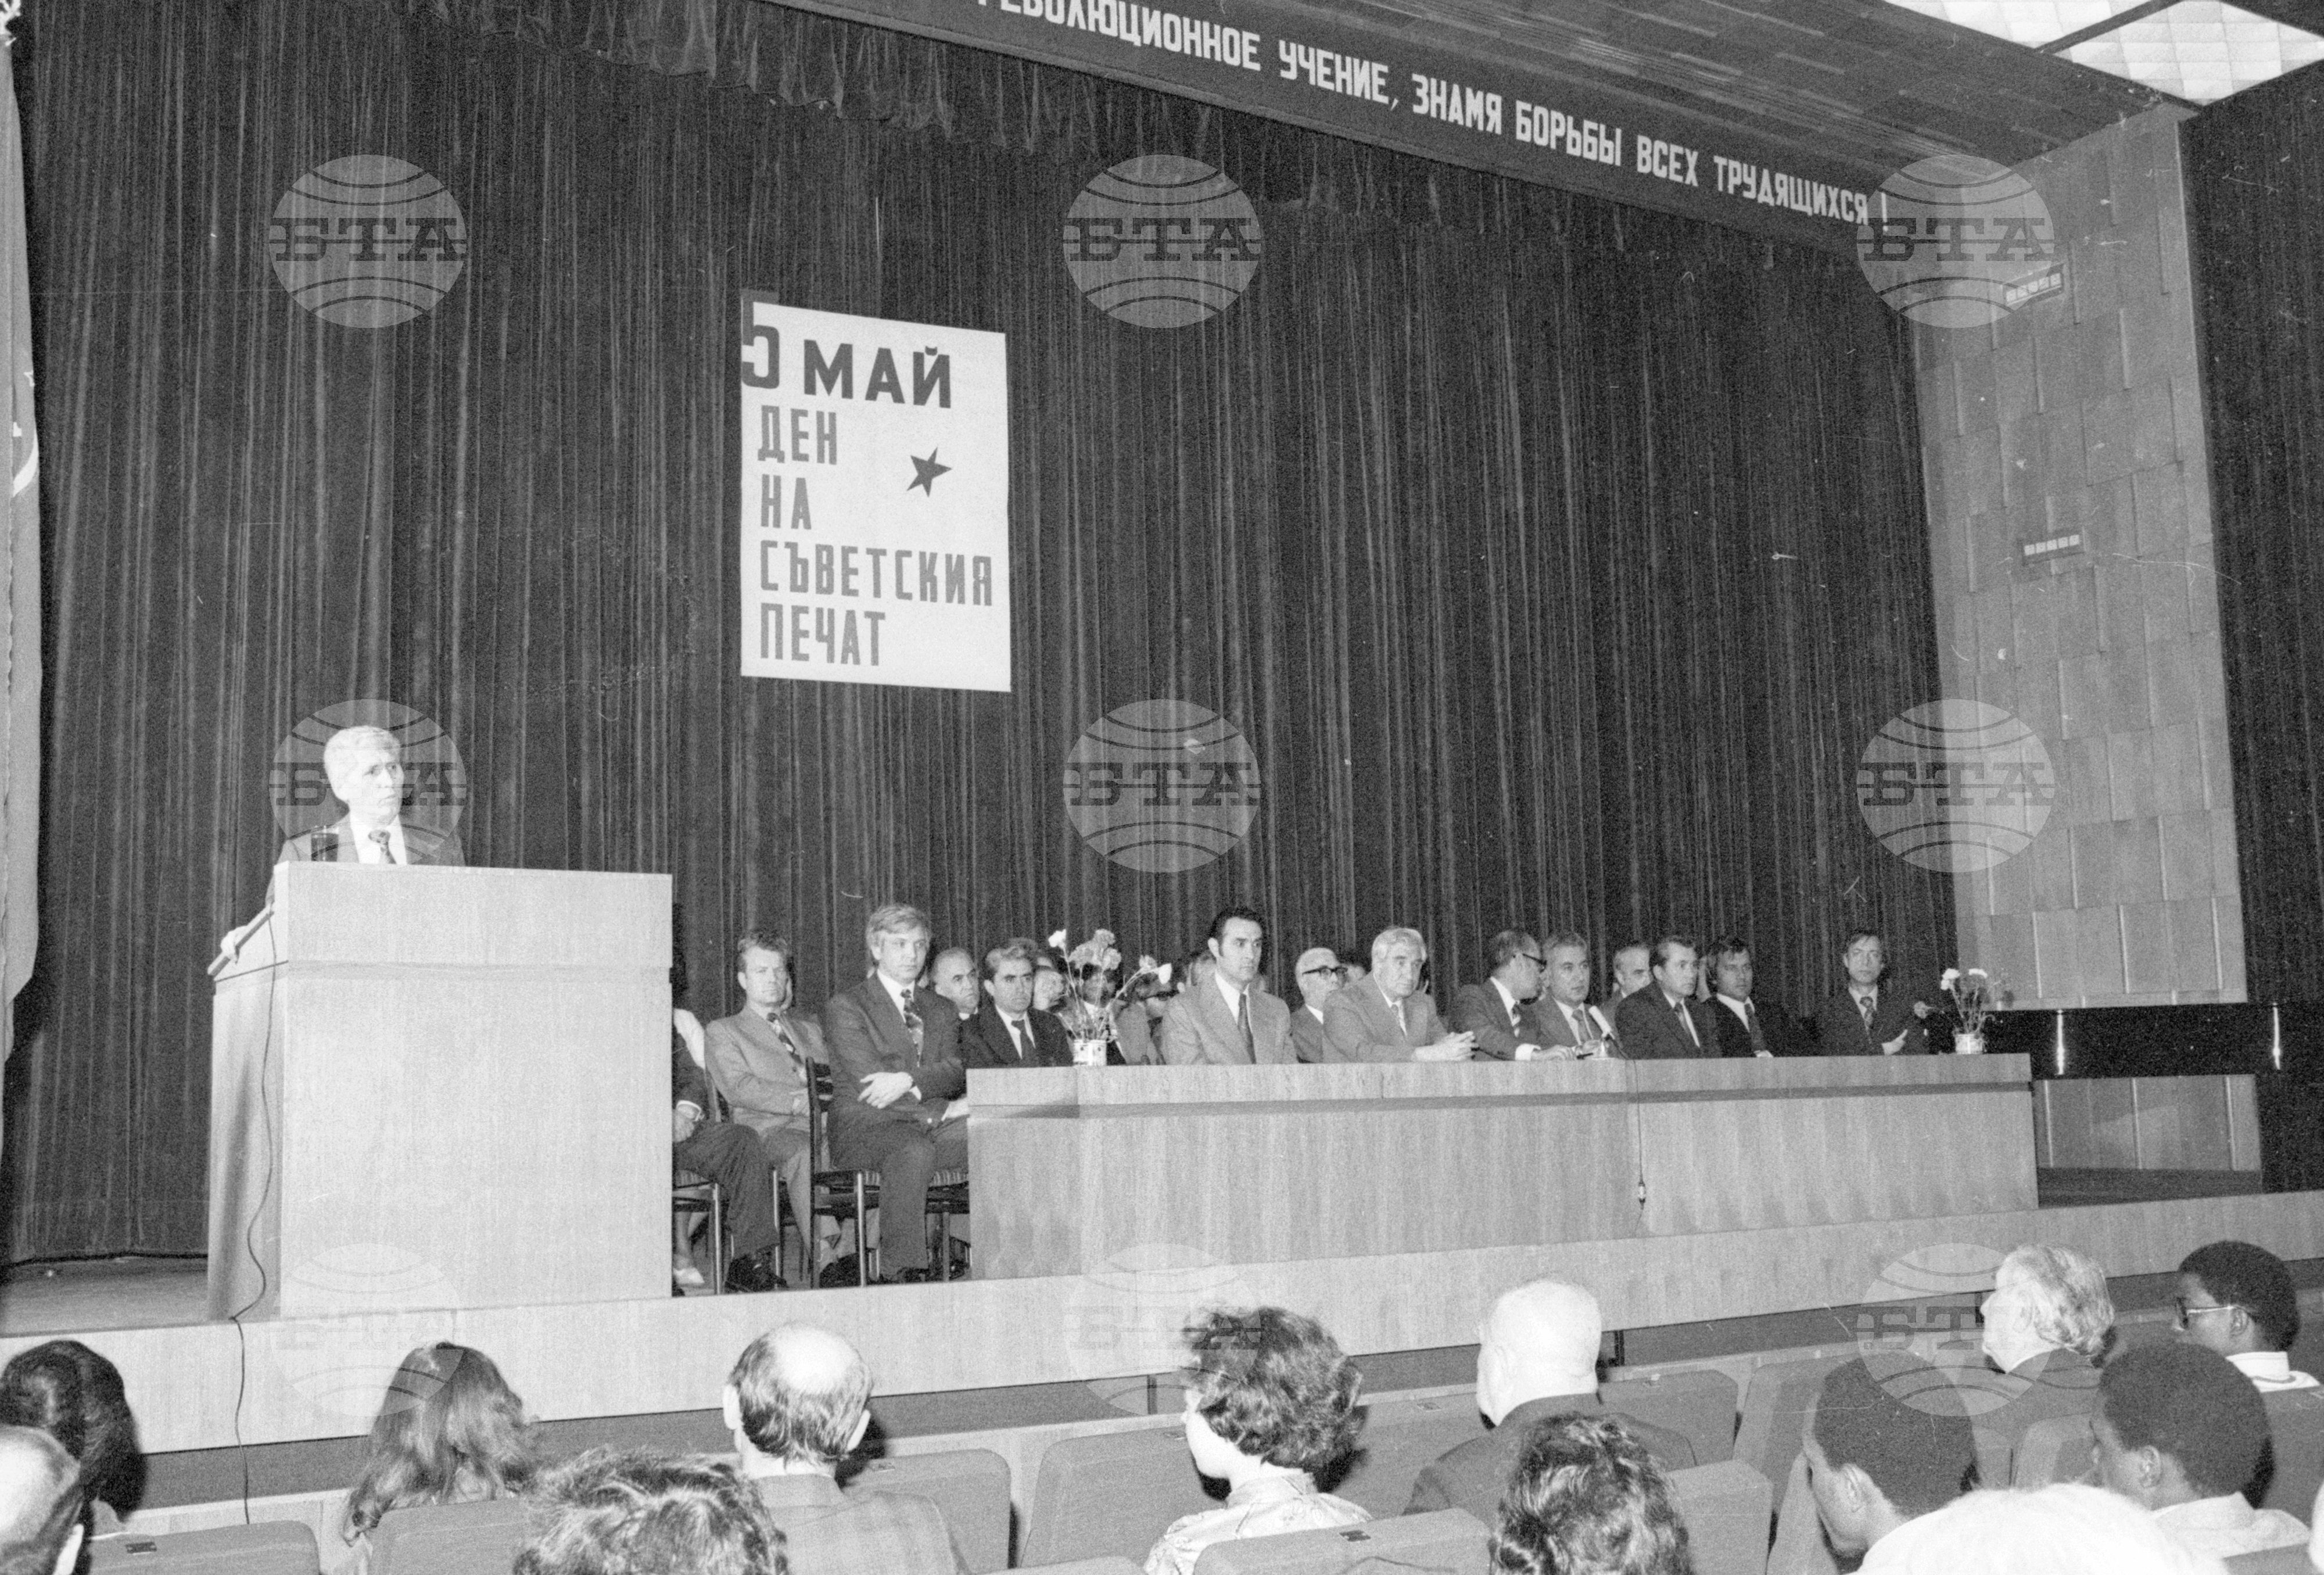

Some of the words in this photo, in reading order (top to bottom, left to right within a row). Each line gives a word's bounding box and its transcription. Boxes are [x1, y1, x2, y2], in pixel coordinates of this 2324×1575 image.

[978, 0, 1260, 71] ОЛЮЦИОННОЕ
[1279, 39, 1399, 111] УЧЕНИЕ,
[1412, 73, 1502, 135] ЗНАМЯ
[1516, 99, 1622, 166] БОРЬБЫ
[1637, 134, 1698, 187] ВСЕХ
[741, 289, 779, 389] 5
[804, 339, 951, 409] МАЙ
[758, 405, 837, 465] ДЕН
[761, 474, 812, 530] НА
[760, 540, 992, 606] СЪВЕТСКИЯ
[760, 602, 885, 667] ПЕЧАТ
